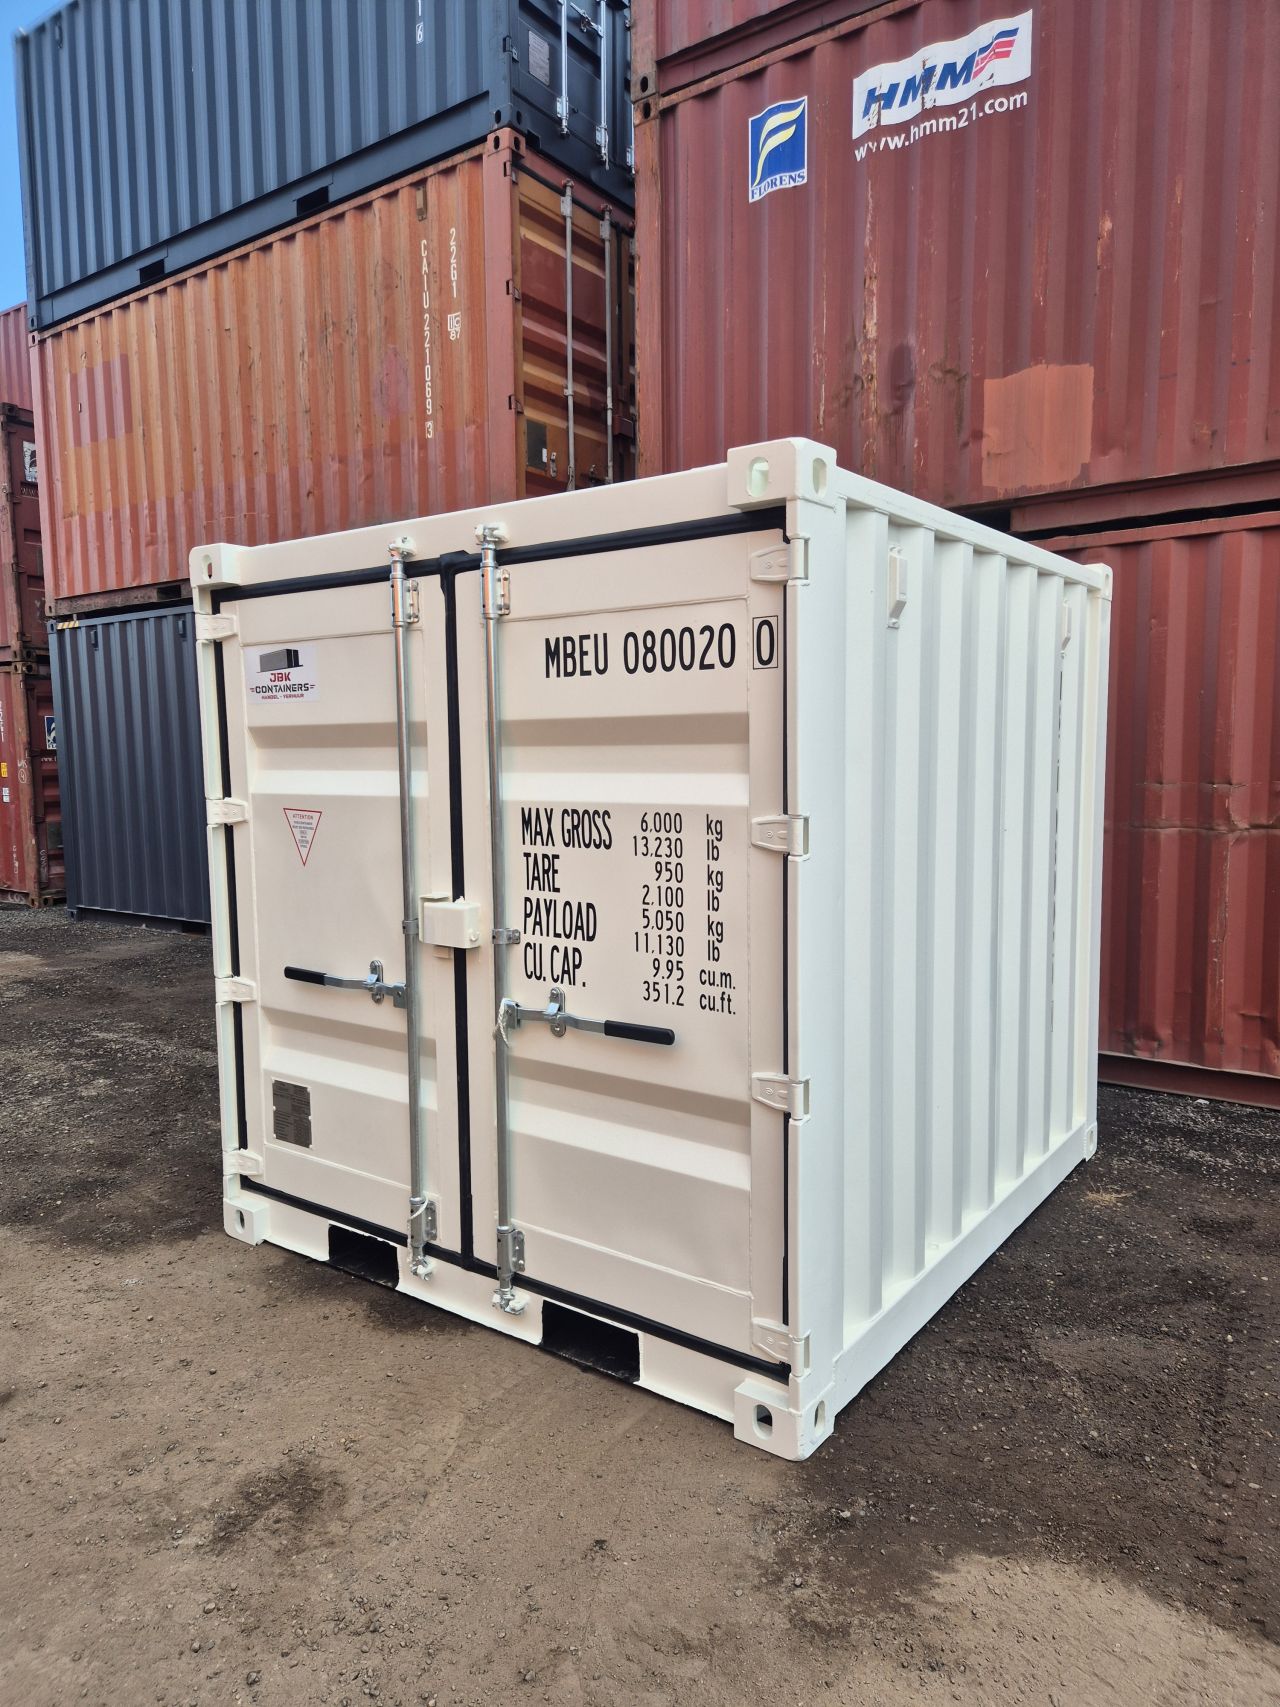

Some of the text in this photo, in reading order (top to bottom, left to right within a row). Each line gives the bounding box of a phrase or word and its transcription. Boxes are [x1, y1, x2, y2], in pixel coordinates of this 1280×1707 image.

[862, 51, 978, 119] HMM
[750, 171, 806, 200] FLORENS
[449, 227, 458, 298] 22G1
[421, 239, 433, 439] CAIU 221069 3
[545, 619, 775, 678] MBEU 080020 0
[255, 682, 310, 694] CONTAINERS
[269, 672, 291, 683] JBK
[521, 807, 556, 847] MAX
[561, 808, 613, 850] GROSS
[706, 814, 723, 842] kg
[706, 839, 720, 861] lb
[523, 852, 724, 893] TARE 950 kg
[707, 890, 720, 912] lb
[523, 896, 597, 942] PAYLOAD
[707, 915, 724, 943] kg
[707, 940, 720, 962] lb
[652, 957, 684, 982] 9.95
[699, 968, 736, 990] cu.m.
[642, 980, 736, 1015] 351.2 cu.ft.
